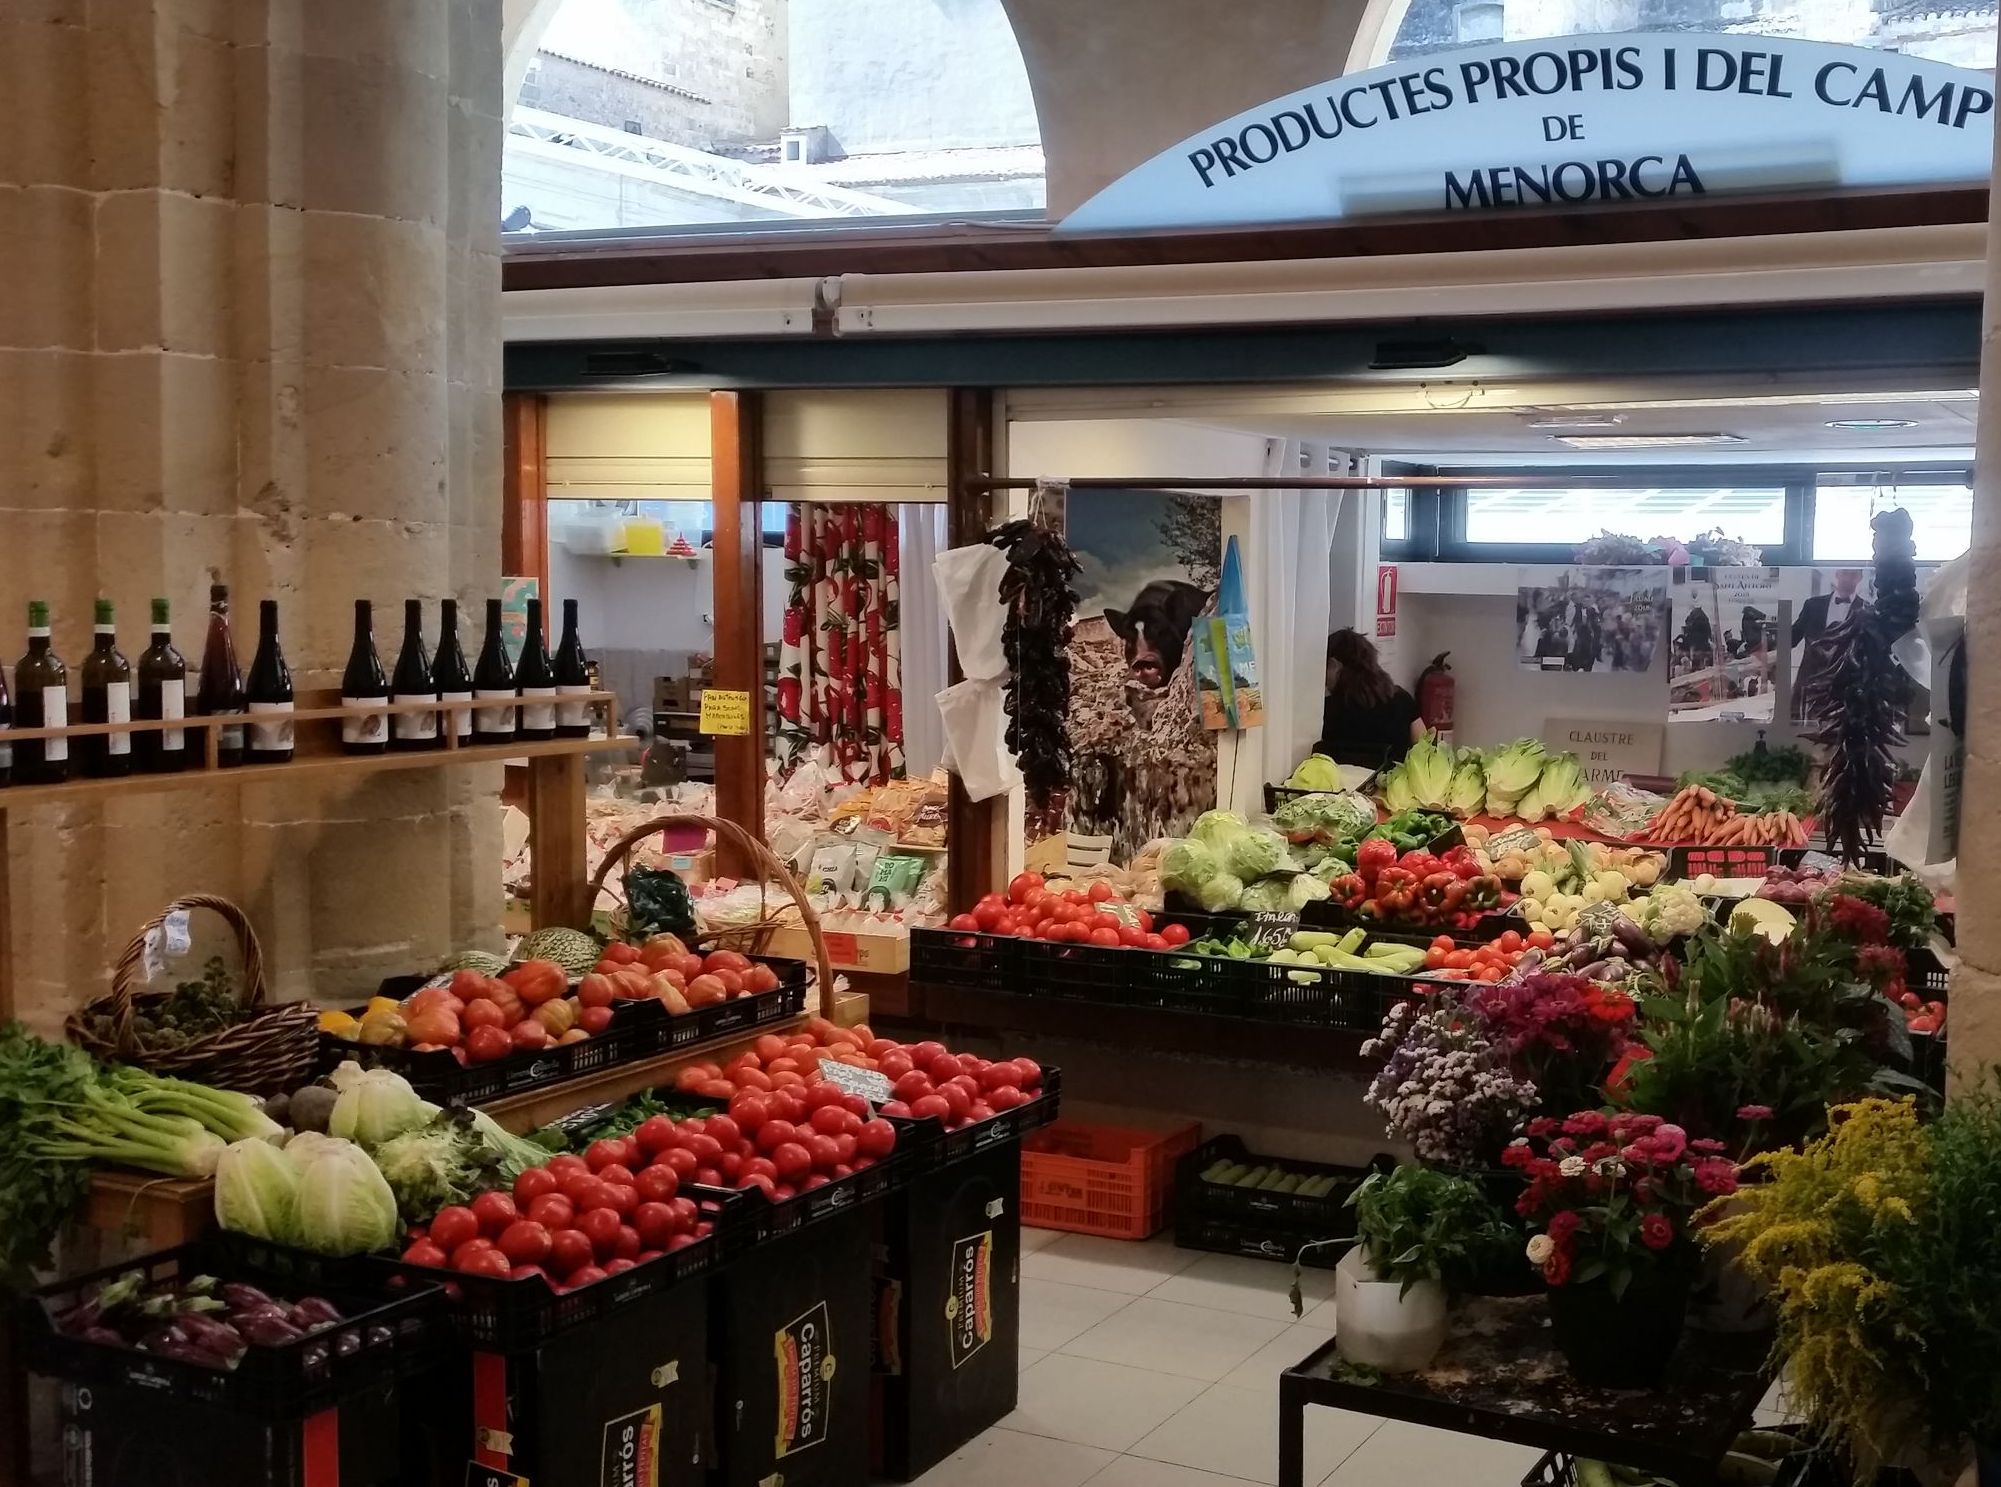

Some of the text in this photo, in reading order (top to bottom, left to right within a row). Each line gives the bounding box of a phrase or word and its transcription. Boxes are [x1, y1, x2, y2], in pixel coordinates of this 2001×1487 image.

[1187, 46, 1994, 188] PRODUCTES PROPIS I DEL CAMP
[1542, 114, 1585, 142] DE
[1444, 153, 1706, 209] MENORCA
[1569, 730, 1635, 746] CLAUSTRE
[1590, 751, 1609, 761] DEL
[962, 1245, 976, 1349] Caparrós
[798, 1322, 815, 1439] Caparrós
